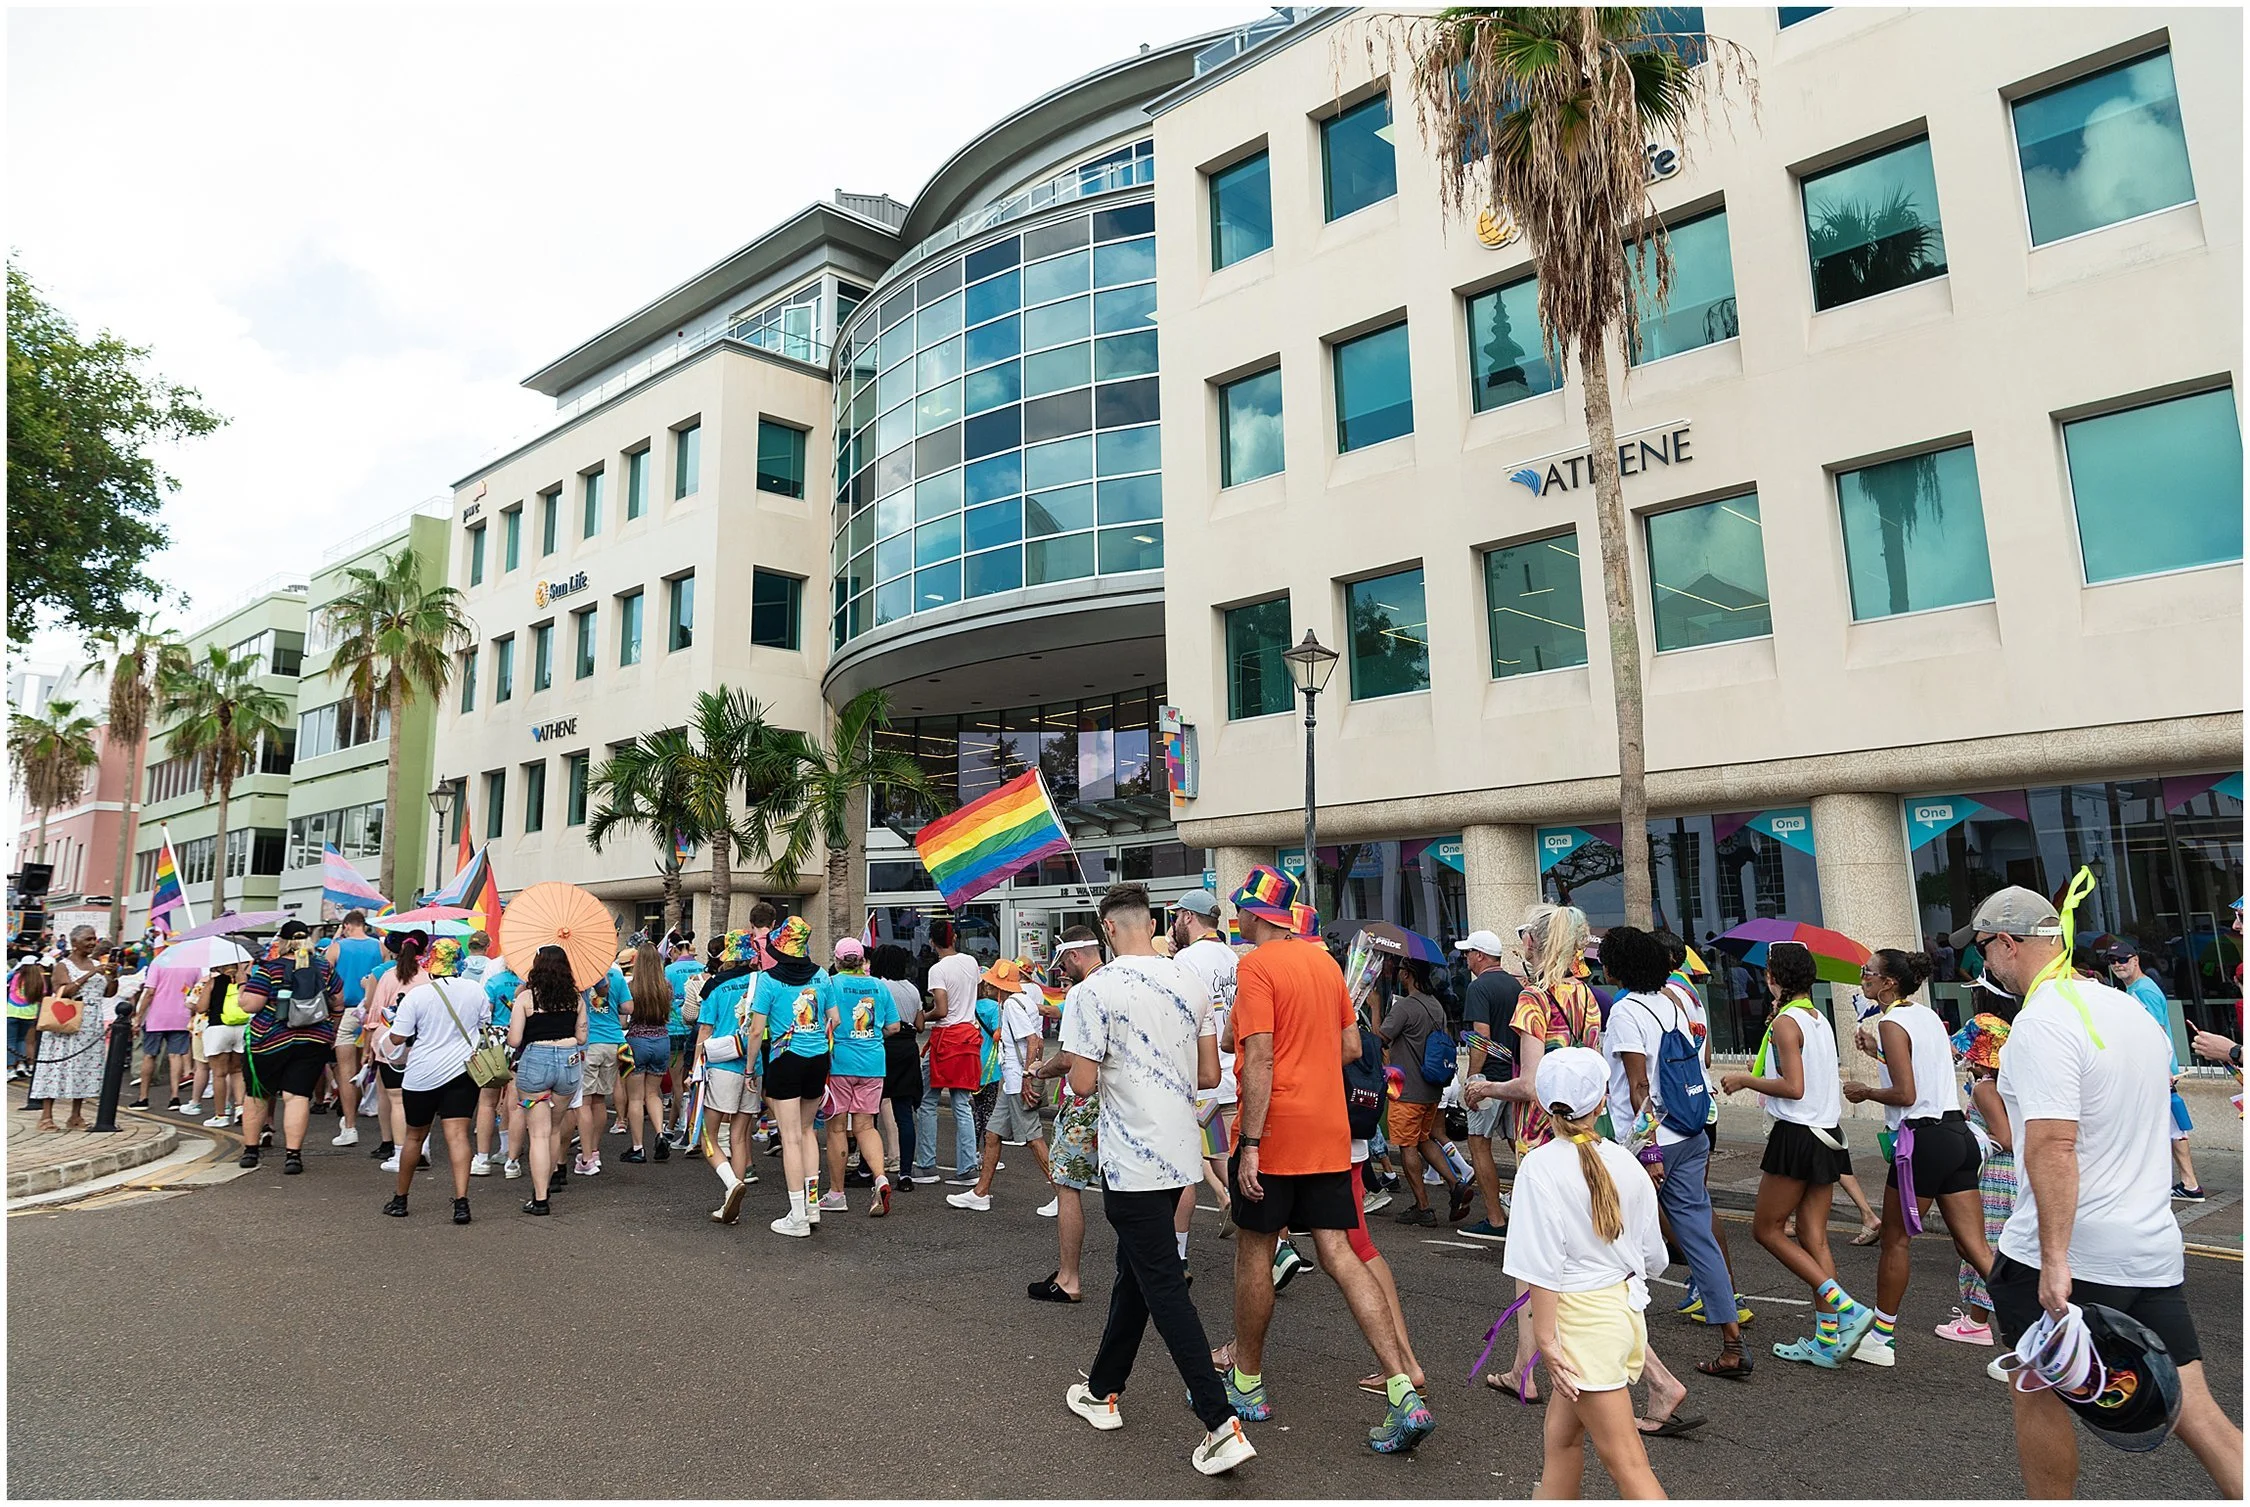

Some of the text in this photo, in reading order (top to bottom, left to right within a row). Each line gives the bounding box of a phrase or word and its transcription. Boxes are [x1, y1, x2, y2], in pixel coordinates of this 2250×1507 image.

[550, 571, 587, 599] Sun Life
[538, 717, 577, 742] ATHENE
[1920, 808, 1946, 818] One
[1776, 819, 1800, 829] One
[1548, 837, 1567, 846] One
[1442, 845, 1460, 854] One
[1076, 885, 1108, 896] WASHIN
[851, 1029, 874, 1038] PRIDE
